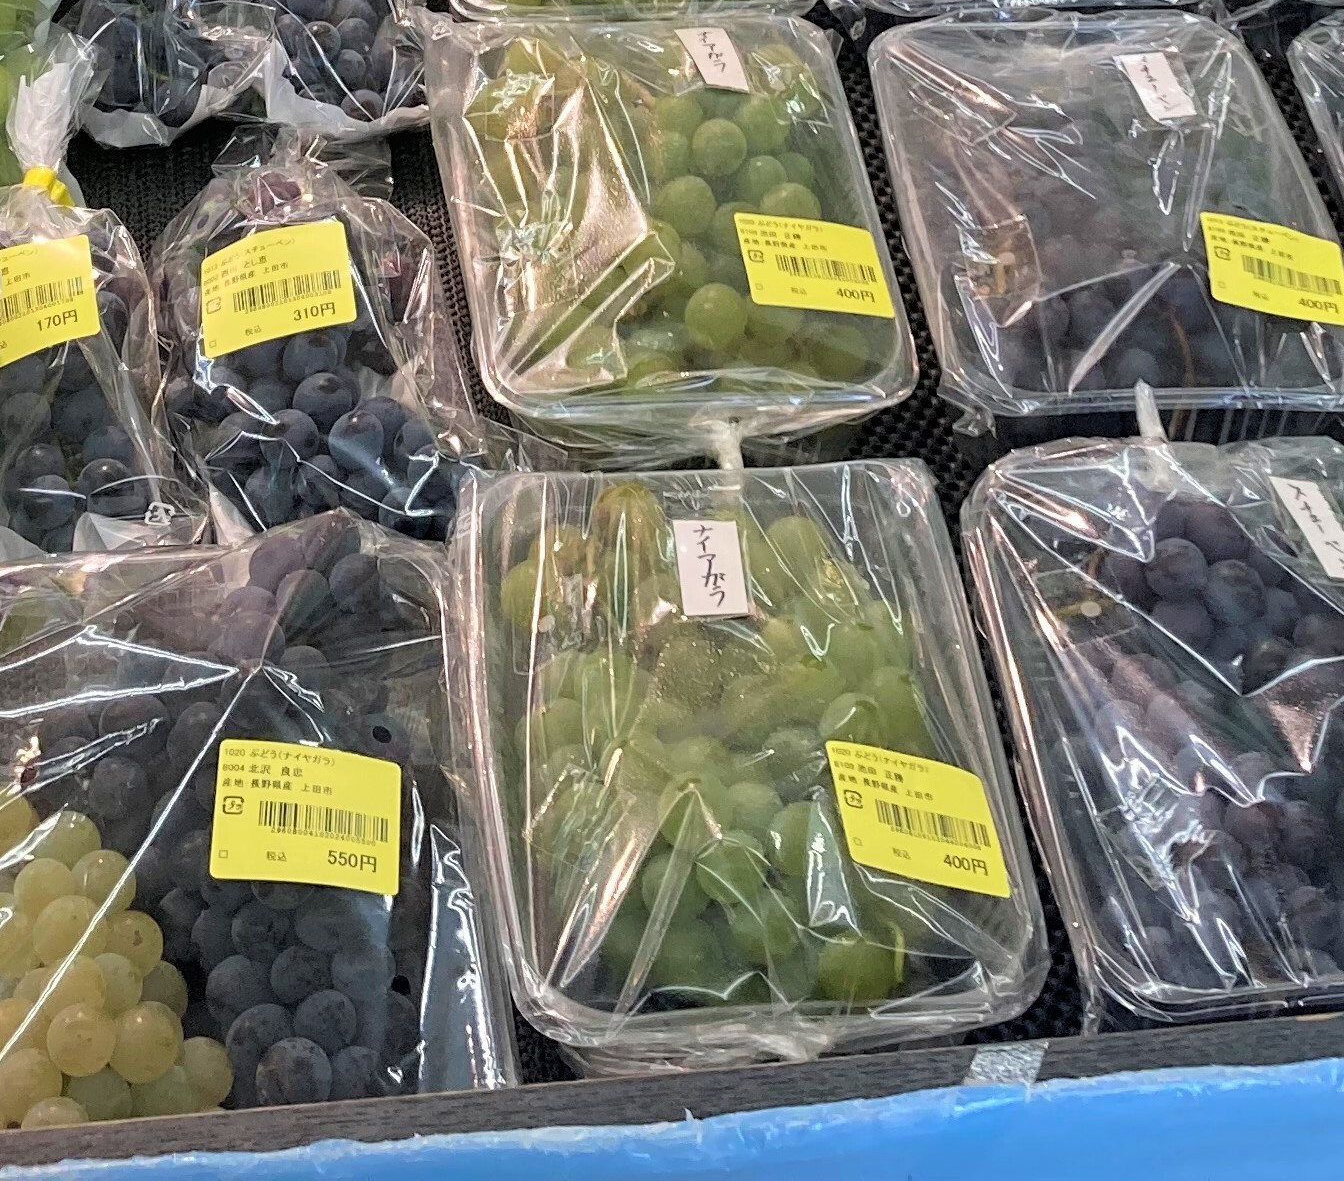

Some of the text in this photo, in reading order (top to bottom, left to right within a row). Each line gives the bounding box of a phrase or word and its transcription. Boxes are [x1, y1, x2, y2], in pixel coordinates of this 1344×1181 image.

[836, 288, 875, 303] 400円
[294, 302, 336, 321] 310円
[1298, 297, 1339, 314] 400円
[36, 309, 78, 331] 170円
[224, 748, 335, 767] 1020 ぶどう(ナイヤガラ)
[222, 778, 333, 796] 産地 長野県産 上田市
[266, 850, 378, 873] 税込 550円
[944, 854, 989, 876] 400円
